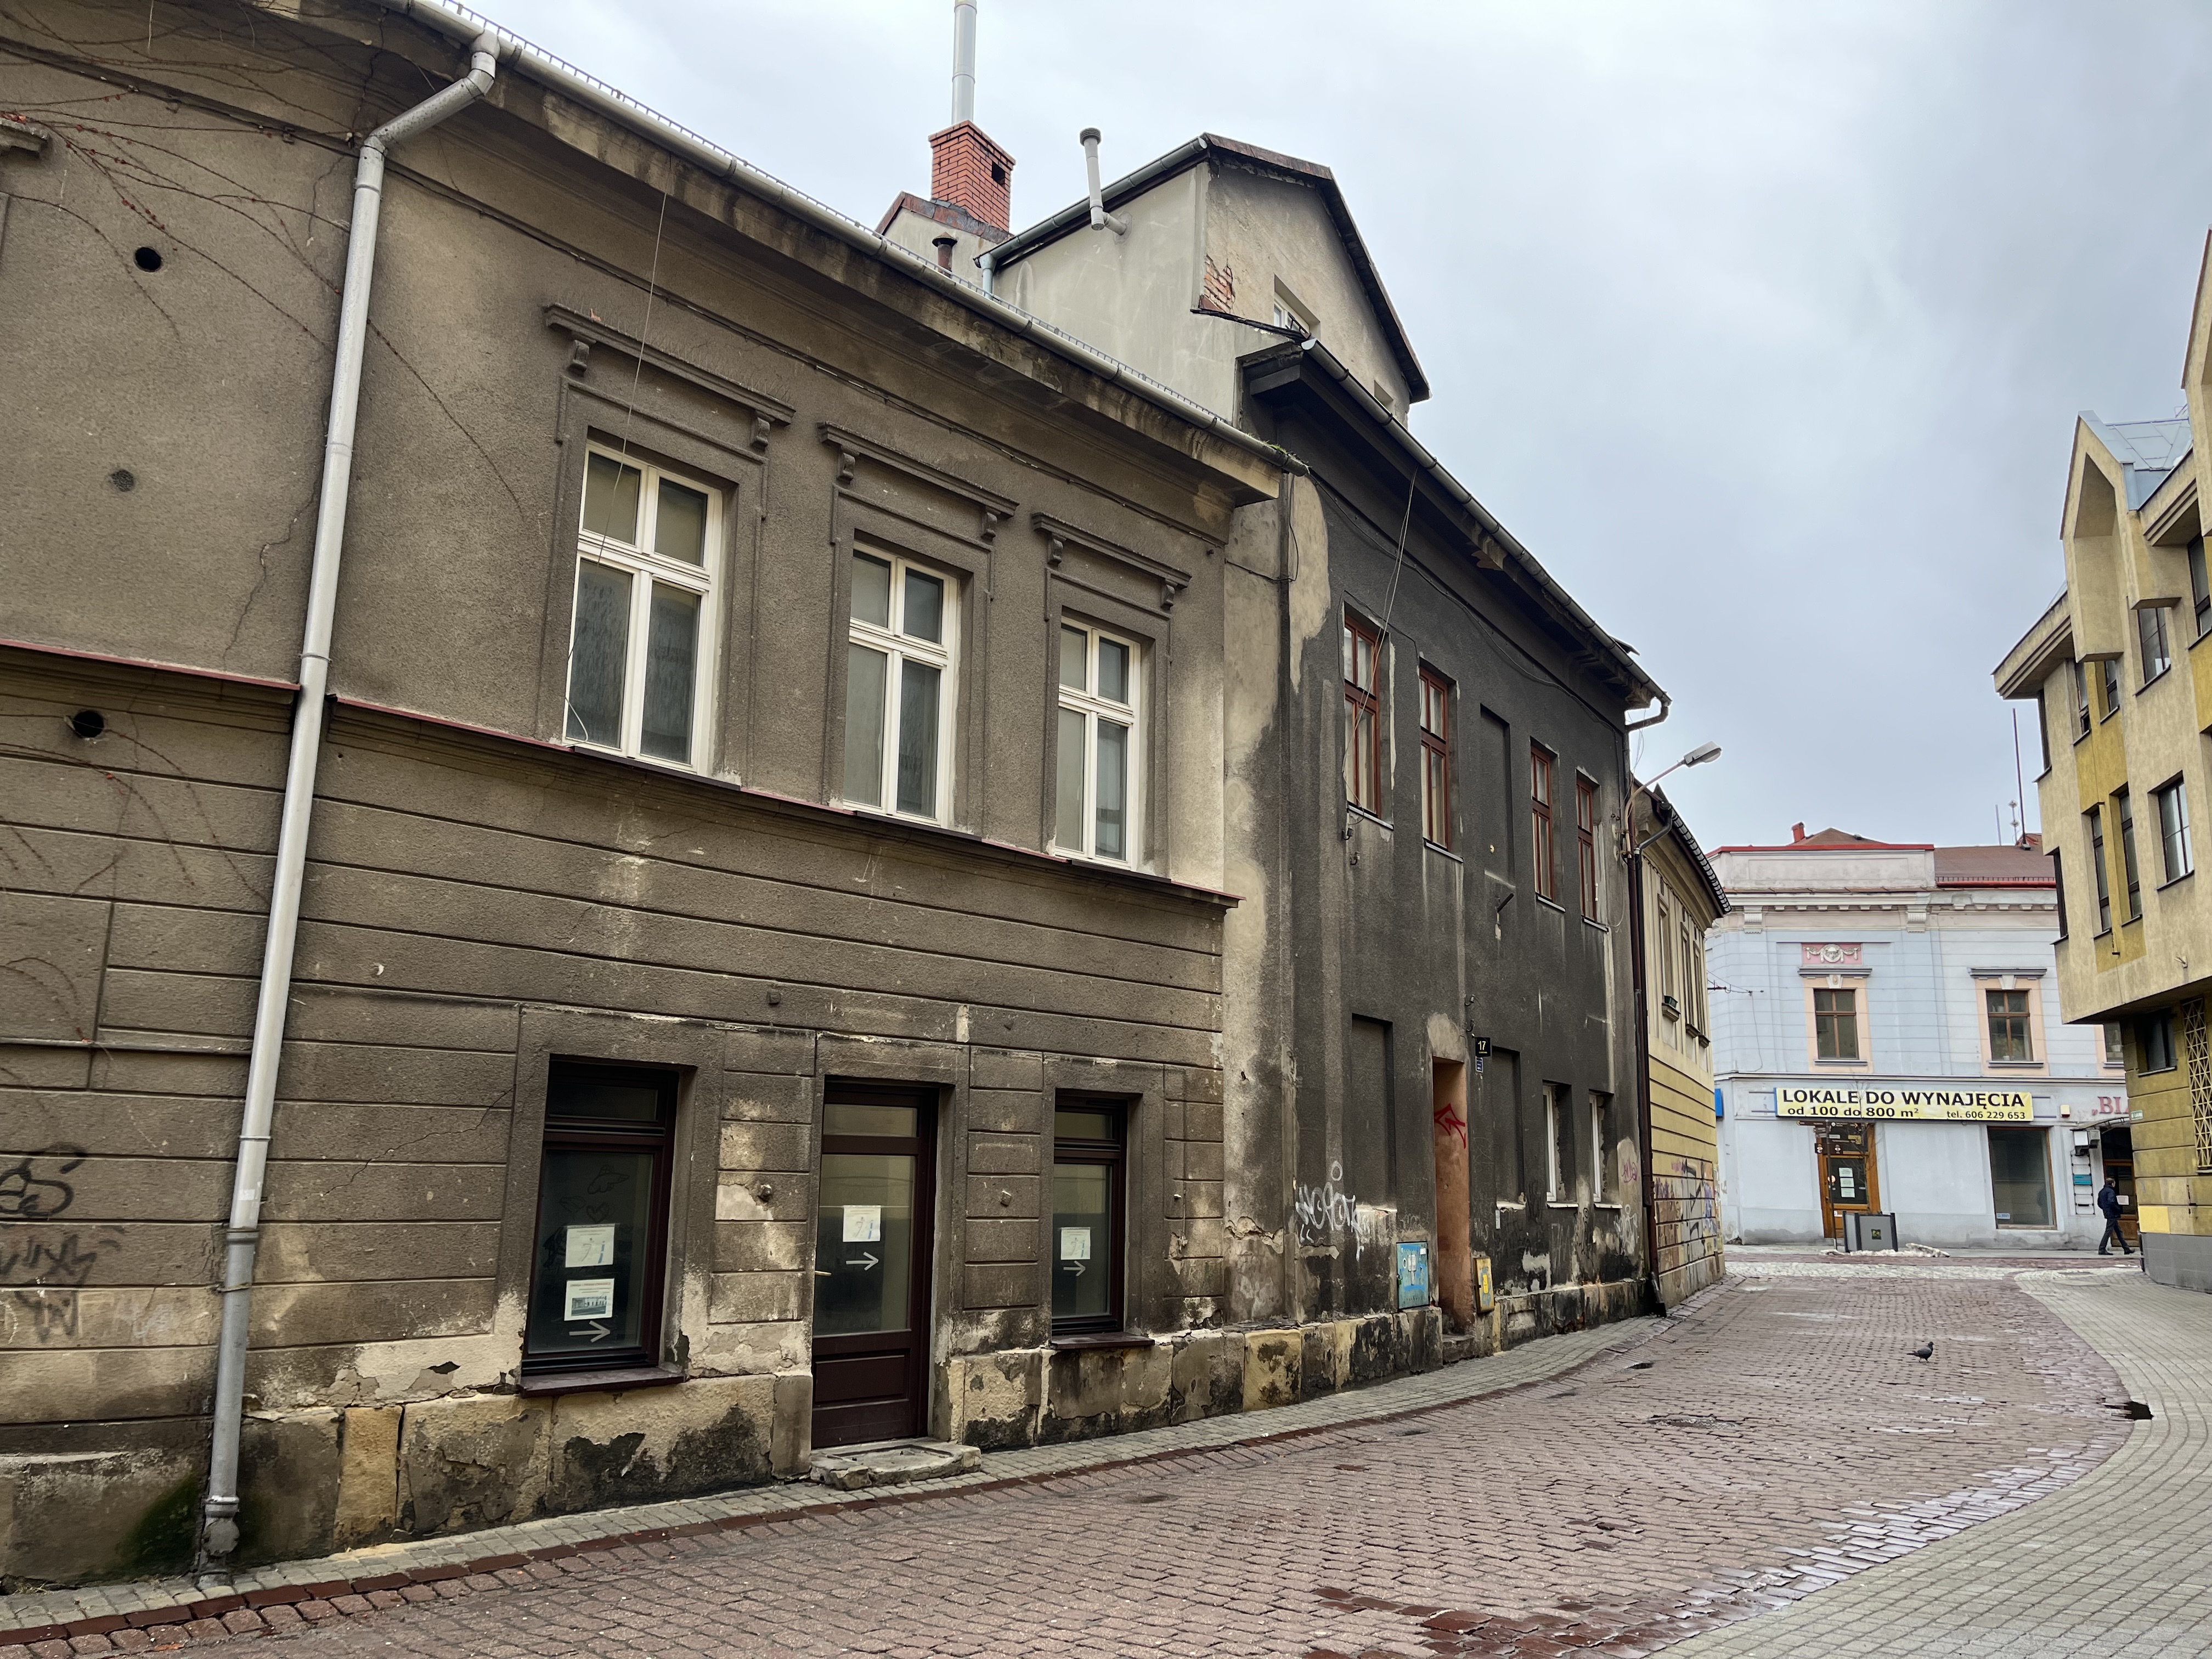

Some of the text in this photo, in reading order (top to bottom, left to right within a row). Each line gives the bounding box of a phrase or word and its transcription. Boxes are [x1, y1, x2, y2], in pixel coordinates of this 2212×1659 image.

[1477, 1040, 1486, 1051] 17
[1783, 1089, 2024, 1109] LOKALE DO WYNAJĘCIA
[1787, 1107, 1804, 1115] od
[1810, 1106, 1838, 1115] 100
[1844, 1107, 1861, 1116] do
[1866, 1107, 1895, 1117] 800
[1987, 1111, 2004, 1119] 229
